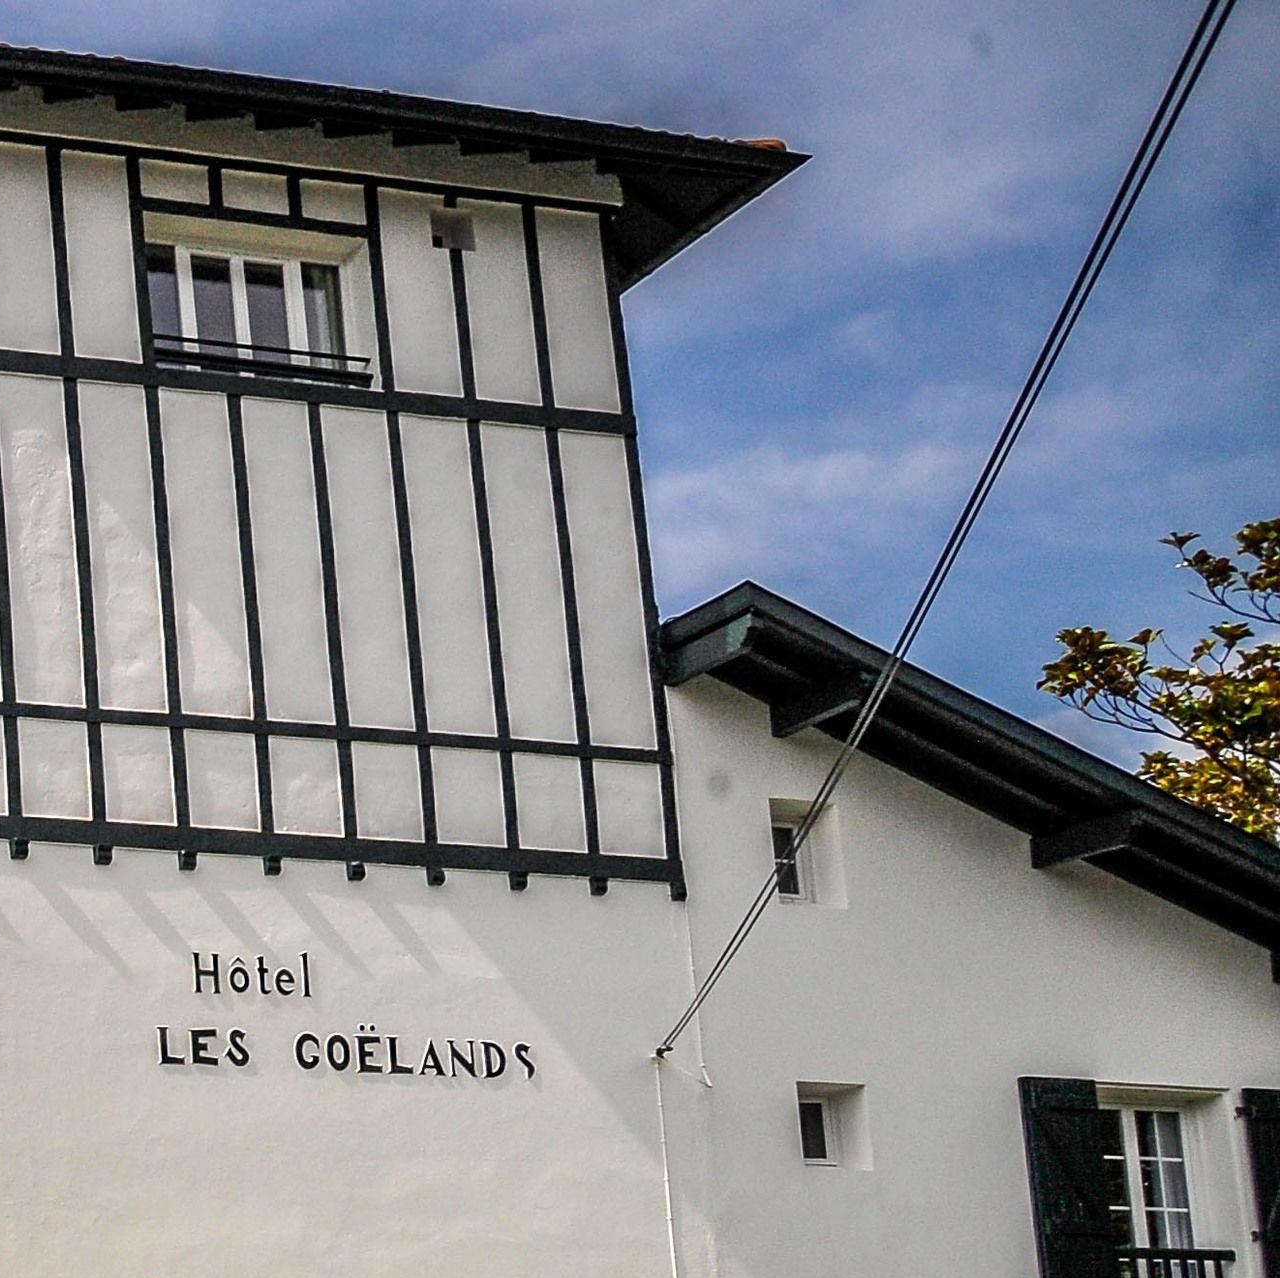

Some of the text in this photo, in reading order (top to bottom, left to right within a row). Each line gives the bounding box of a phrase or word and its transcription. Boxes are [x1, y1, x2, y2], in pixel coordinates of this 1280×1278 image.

[192, 951, 313, 998] Hôtel
[155, 1023, 537, 1080] LES GOËLANDS
